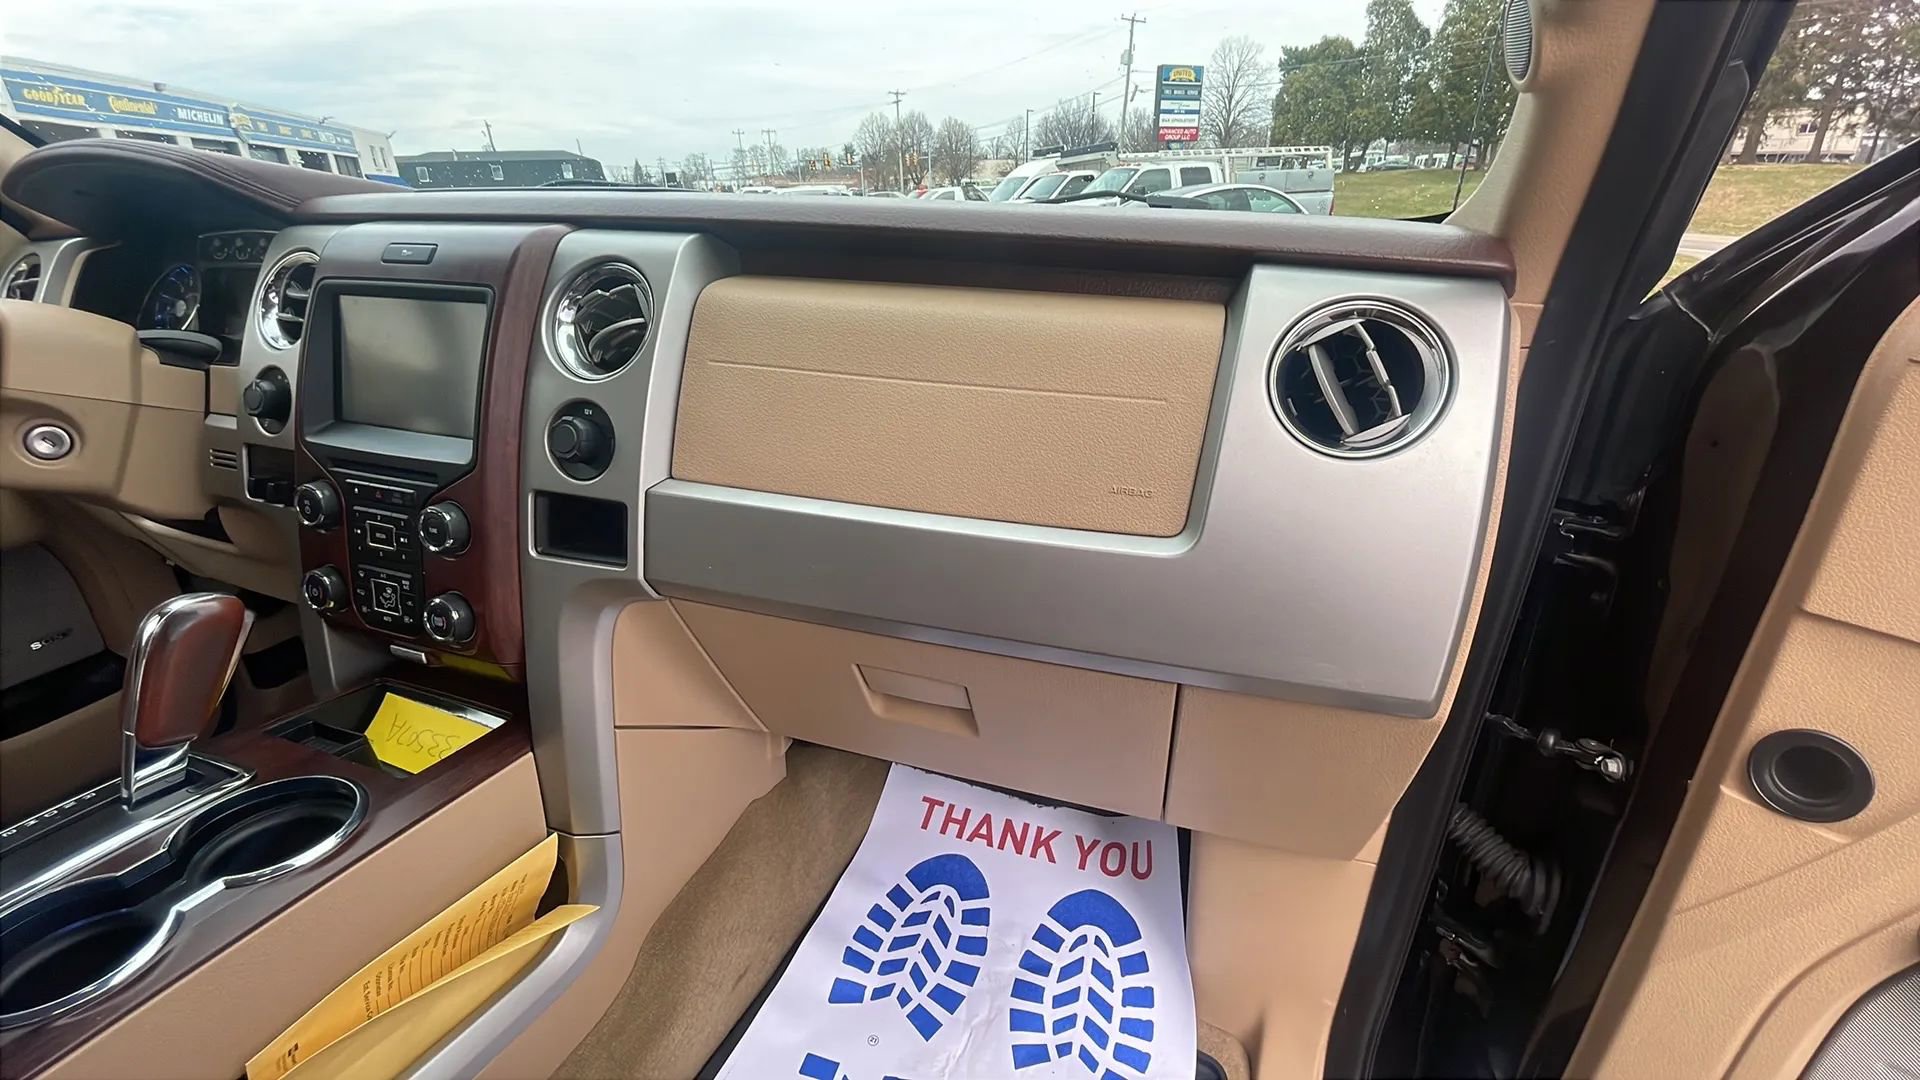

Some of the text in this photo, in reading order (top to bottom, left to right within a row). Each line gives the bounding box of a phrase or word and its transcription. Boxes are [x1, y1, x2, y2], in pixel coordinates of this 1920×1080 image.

[23, 87, 86, 106] GOODYEAR
[176, 107, 225, 125] MICHELIN
[920, 796, 1153, 880] THANK YOU
